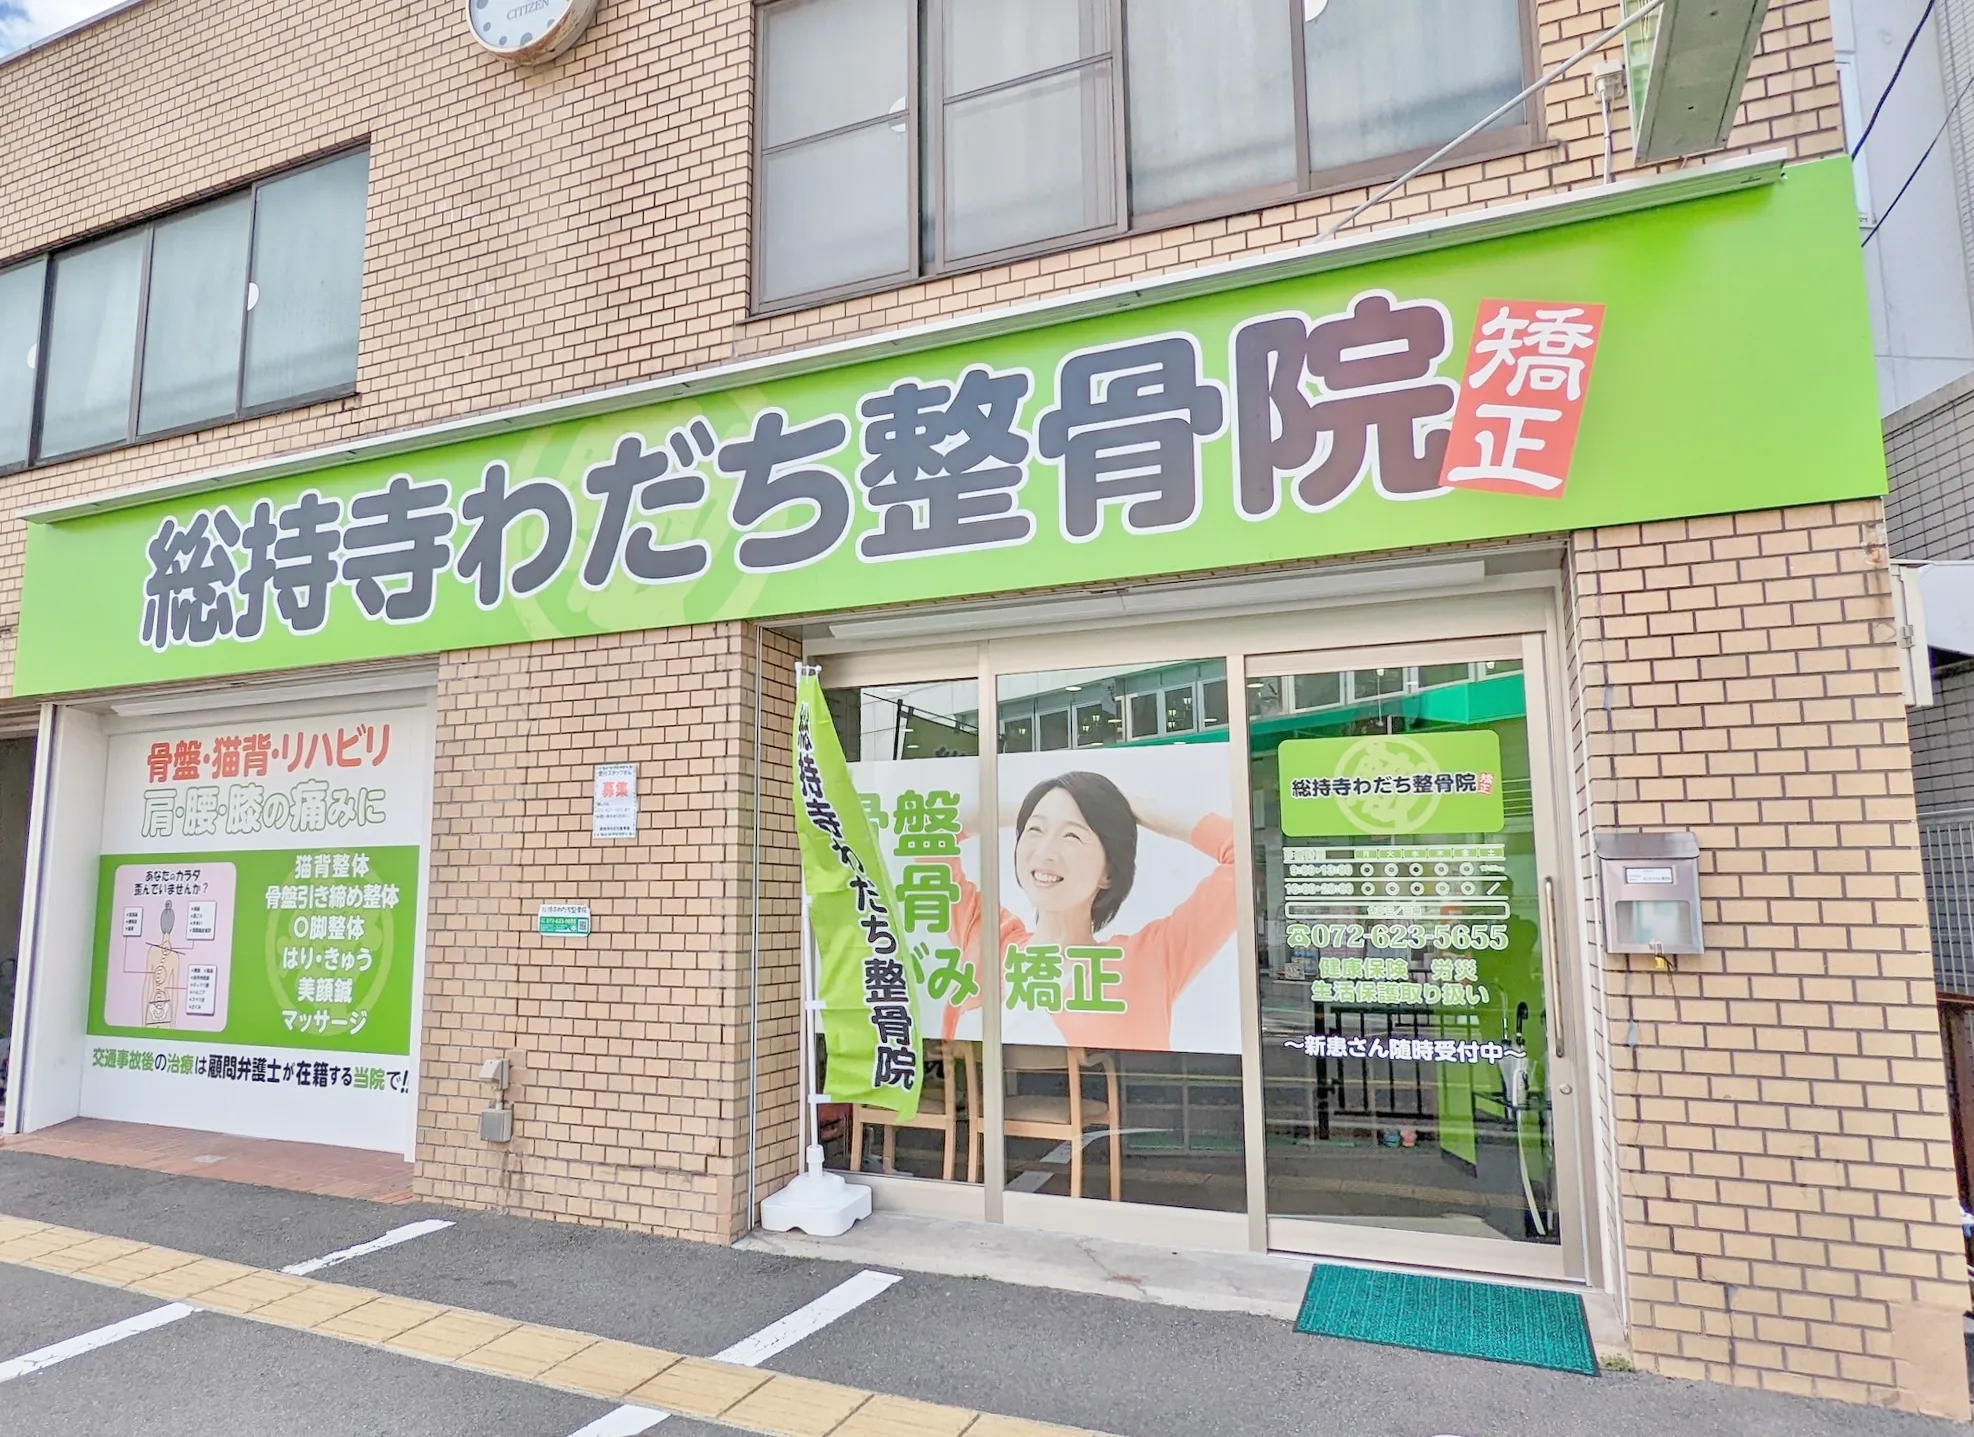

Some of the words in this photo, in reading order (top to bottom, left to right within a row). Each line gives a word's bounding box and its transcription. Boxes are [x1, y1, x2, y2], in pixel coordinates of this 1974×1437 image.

[506, 0, 550, 20] CITIZEN
[1447, 305, 1595, 492] 矯正
[139, 288, 1457, 653] 総持寺わだち整骨院
[147, 724, 390, 783] 骨盤・猫背・リハビリ
[602, 781, 629, 797] 募集
[1291, 773, 1476, 797] 総持寺わだち整骨院
[141, 778, 386, 837] 肩・腰・膝の痛みに
[145, 869, 201, 881] あなたのカラダ
[295, 853, 370, 879] 猫背整体
[134, 883, 208, 896] 歪んでいませんか？
[265, 884, 400, 909] 骨盤引き締め整体
[1311, 924, 1509, 950] 072-623-5655
[282, 947, 372, 971] はり・きゅう
[1319, 957, 1409, 981] 健康保険
[1430, 958, 1479, 982] 労災
[297, 977, 353, 1003] 美顔鍼
[1004, 944, 1127, 1012] 矯正
[1311, 981, 1490, 1005] 生活保護取り扱い
[281, 1009, 368, 1034] マッサージ
